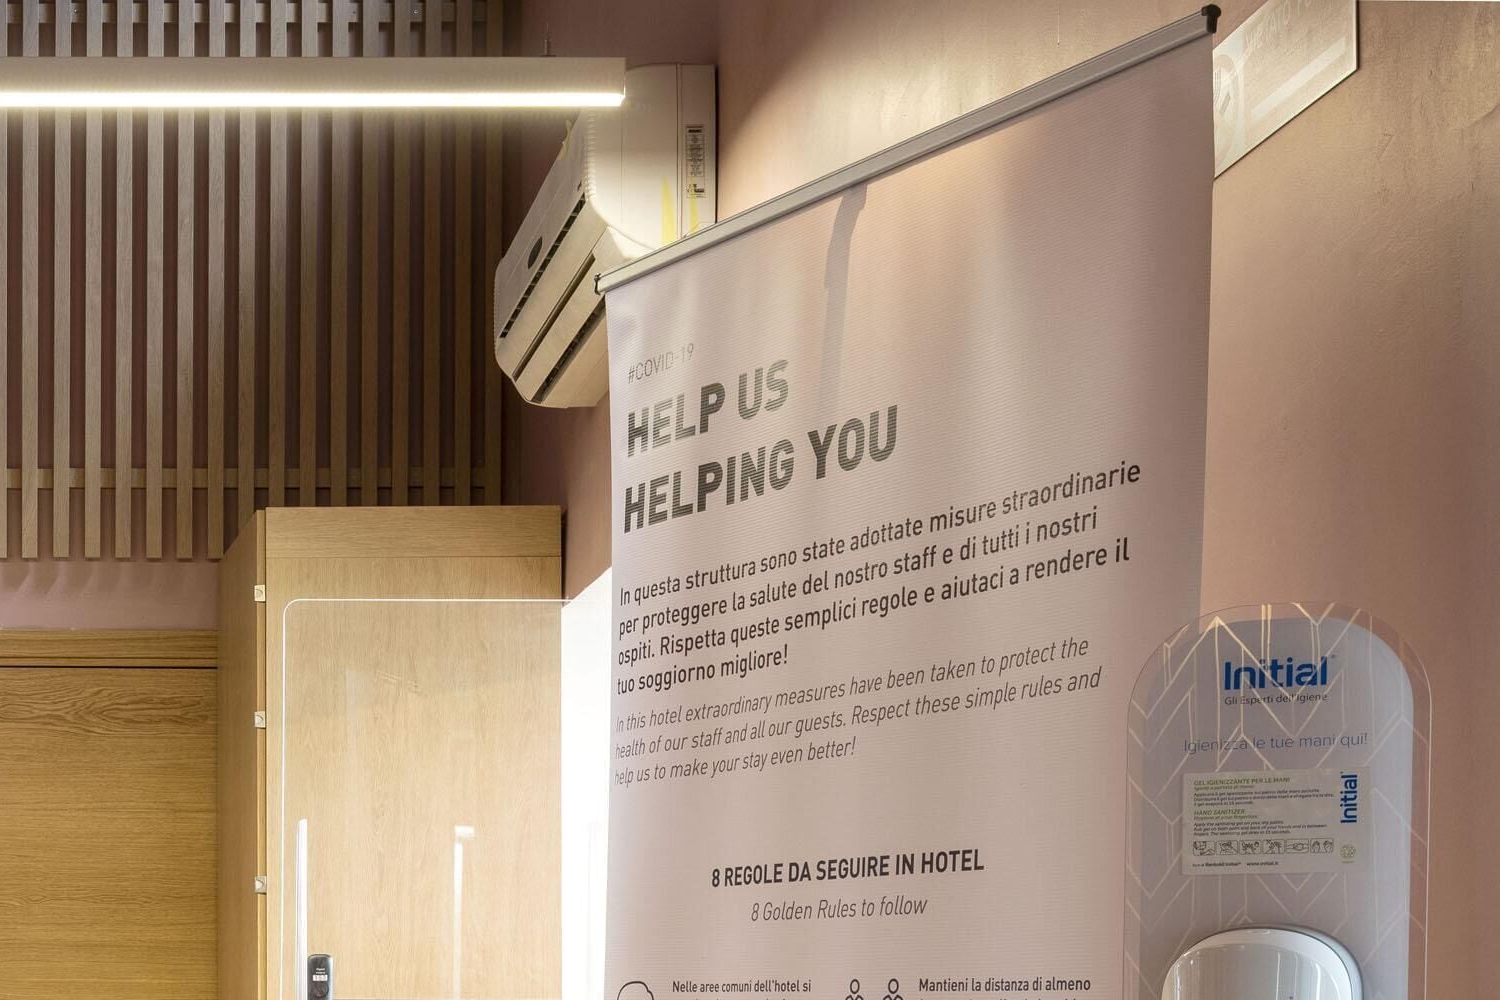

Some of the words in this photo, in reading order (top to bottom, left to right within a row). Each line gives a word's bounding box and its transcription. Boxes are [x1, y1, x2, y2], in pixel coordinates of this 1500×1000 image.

[628, 343, 695, 384] #COVID-19
[626, 381, 725, 458] HELP
[737, 359, 789, 420] US
[623, 439, 795, 534] HELPING
[808, 404, 898, 480] YOU
[620, 588, 631, 607] In
[634, 576, 681, 606] questa
[685, 560, 756, 590] struttura
[760, 550, 797, 573] sono
[802, 537, 845, 563] state
[850, 517, 923, 551] adottate
[930, 501, 997, 533] misure
[1002, 460, 1141, 515] straordinarie
[619, 617, 639, 641] per
[642, 599, 727, 635] proteggere
[732, 591, 745, 612] la
[749, 581, 797, 608] salute
[802, 570, 829, 595] del
[834, 561, 888, 589] nostro
[893, 544, 937, 575] staff
[942, 547, 953, 565] e
[960, 536, 976, 561] di
[982, 525, 1019, 556] tutti
[1025, 522, 1030, 545] i
[1036, 505, 1097, 542] nostri
[618, 639, 655, 667] ospiti.
[660, 628, 726, 657] Rispetta
[730, 616, 780, 648] queste
[784, 597, 856, 631] semplici
[861, 586, 918, 618] regole
[924, 586, 935, 603] e
[941, 565, 1004, 601] aiutaci
[1009, 567, 1019, 585] a
[1026, 548, 1107, 582] rendere
[1115, 537, 1130, 563] il
[616, 720, 624, 732] In
[626, 711, 646, 731] this
[649, 705, 682, 727] hotel
[685, 695, 773, 722] extraordinary
[775, 683, 846, 707] measures
[849, 676, 883, 696] have
[886, 669, 925, 689] been
[930, 659, 976, 682] taken
[981, 655, 995, 674] to
[998, 641, 1057, 677] protect
[1061, 636, 1089, 659] the
[617, 678, 635, 695] tuo
[638, 664, 715, 693] soggiorno
[720, 643, 788, 678] migliore!
[1225, 656, 1328, 690] Initial
[1271, 738, 1294, 749] tue
[1299, 736, 1337, 748] mani
[1341, 733, 1368, 748] qui!
[1340, 774, 1358, 823] Initial
[711, 868, 720, 888] 8
[724, 863, 784, 887] REGOLE
[788, 861, 812, 882] DA
[816, 855, 890, 881] SEGUIRE
[895, 853, 915, 875] IN
[921, 849, 985, 874] HOTEL
[751, 902, 760, 922] 8
[762, 900, 813, 921] Golden
[817, 898, 857, 919] Rules
[861, 899, 875, 917] to
[879, 895, 928, 916] follow
[672, 980, 698, 993] Nelle
[699, 983, 720, 993] aree
[721, 980, 752, 993] comuni
[802, 979, 811, 993] si
[919, 977, 969, 992] Mantieni
[971, 977, 982, 992] la
[984, 977, 1029, 992] distanza
[1032, 976, 1042, 992] di
[1045, 976, 1091, 991] almeno
